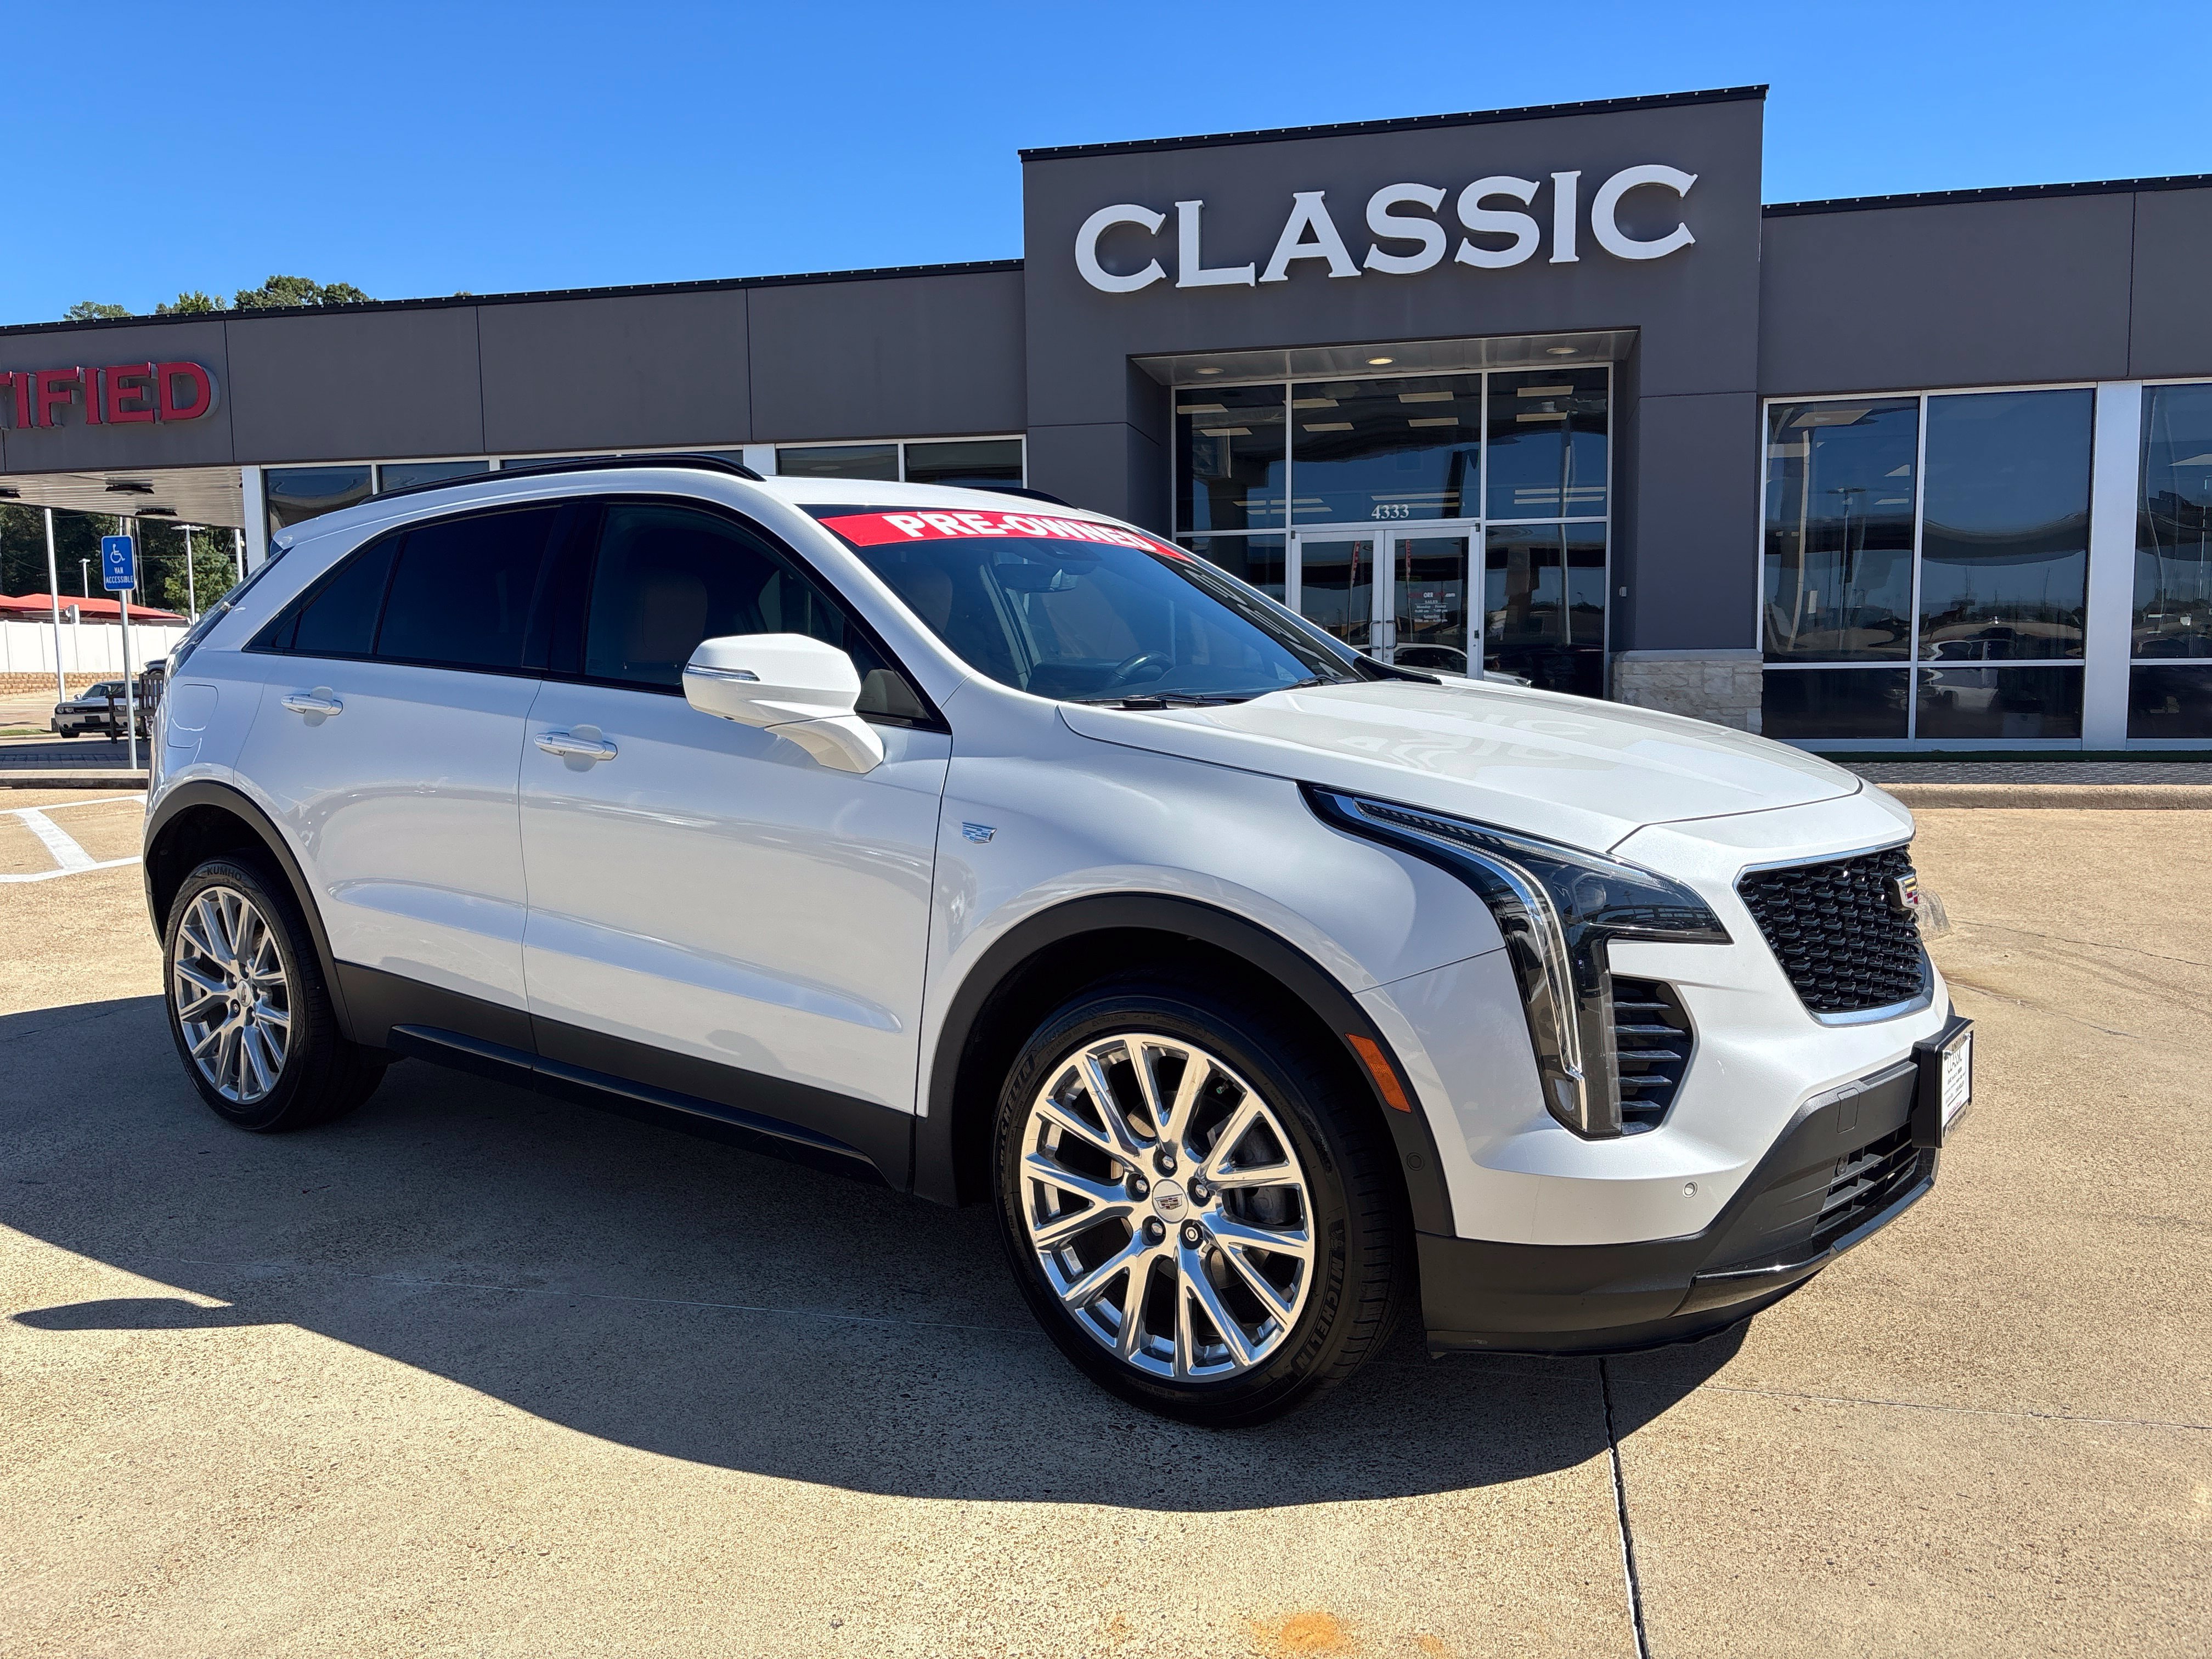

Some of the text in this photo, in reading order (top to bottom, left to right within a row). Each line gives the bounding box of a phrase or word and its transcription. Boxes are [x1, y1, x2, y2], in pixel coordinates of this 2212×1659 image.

[1075, 164, 1699, 294] CLASSIC
[0, 362, 212, 429] IFIED
[1371, 504, 1409, 519] 4333
[881, 514, 1157, 551] PRE-OWNED
[106, 575, 133, 584] ACCESSIBLE
[206, 866, 242, 881] KUMHO
[1295, 1256, 1344, 1369] MICHELIN
